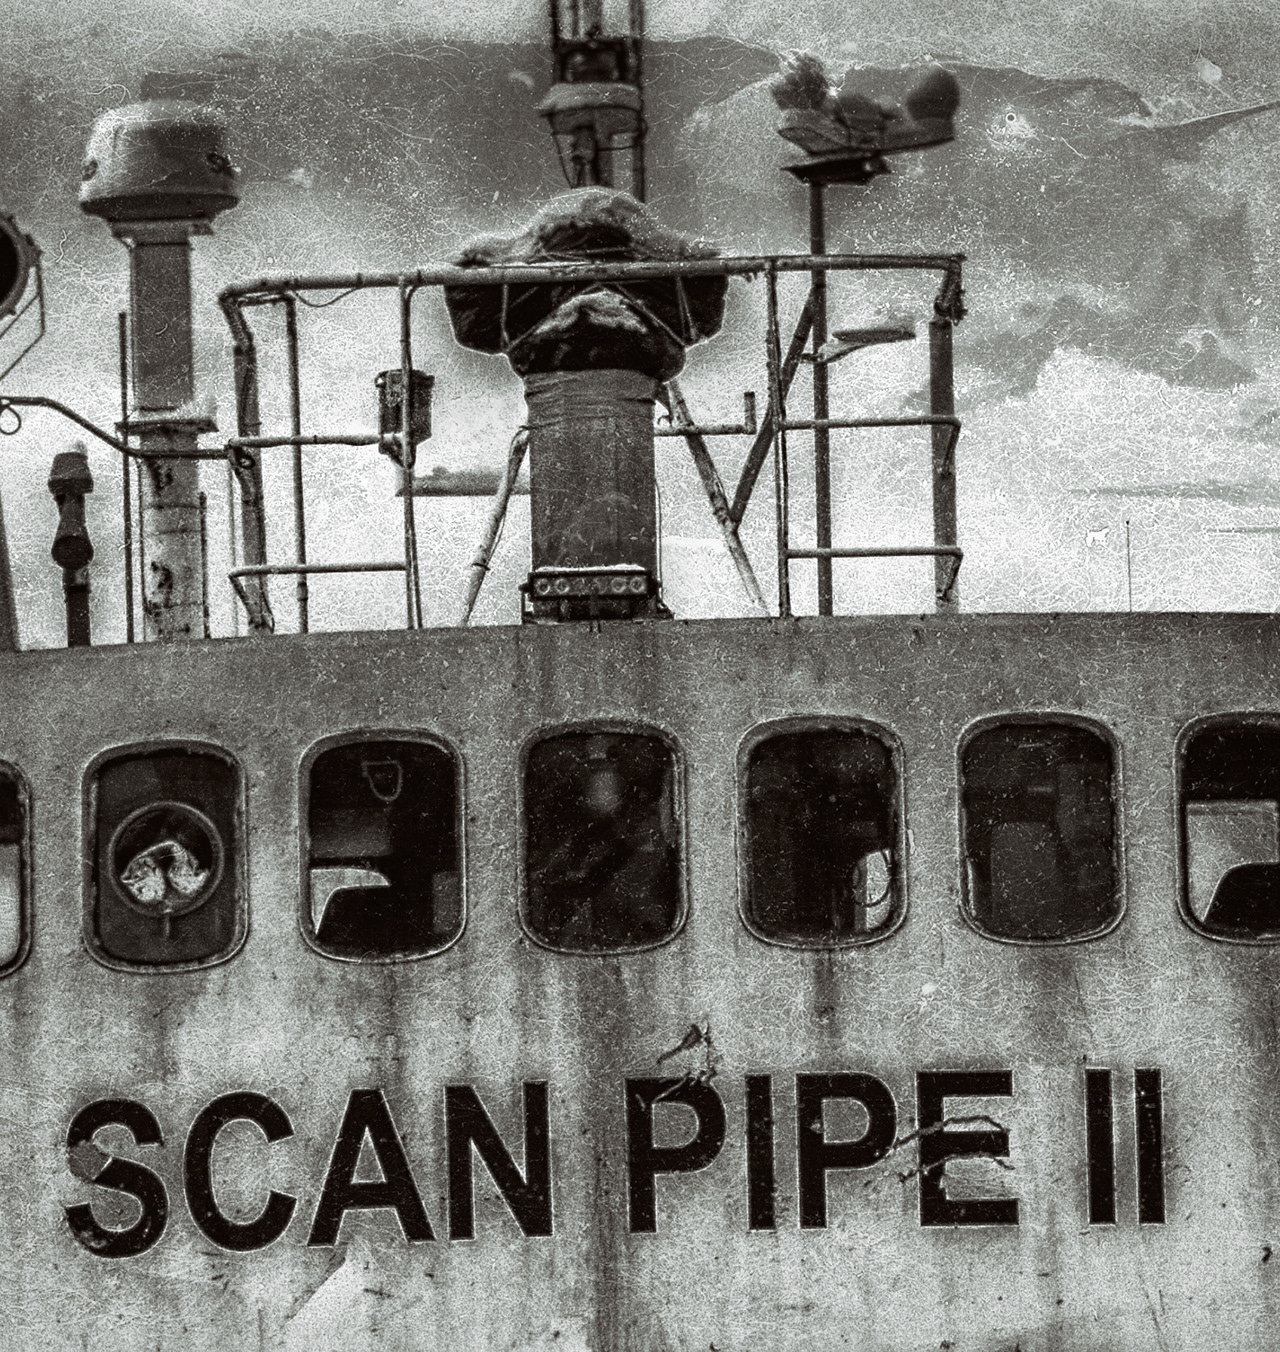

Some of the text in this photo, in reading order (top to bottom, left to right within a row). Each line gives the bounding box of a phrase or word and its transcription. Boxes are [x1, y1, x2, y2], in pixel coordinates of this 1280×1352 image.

[66, 1068, 1164, 1258] SCAN PIPE II
